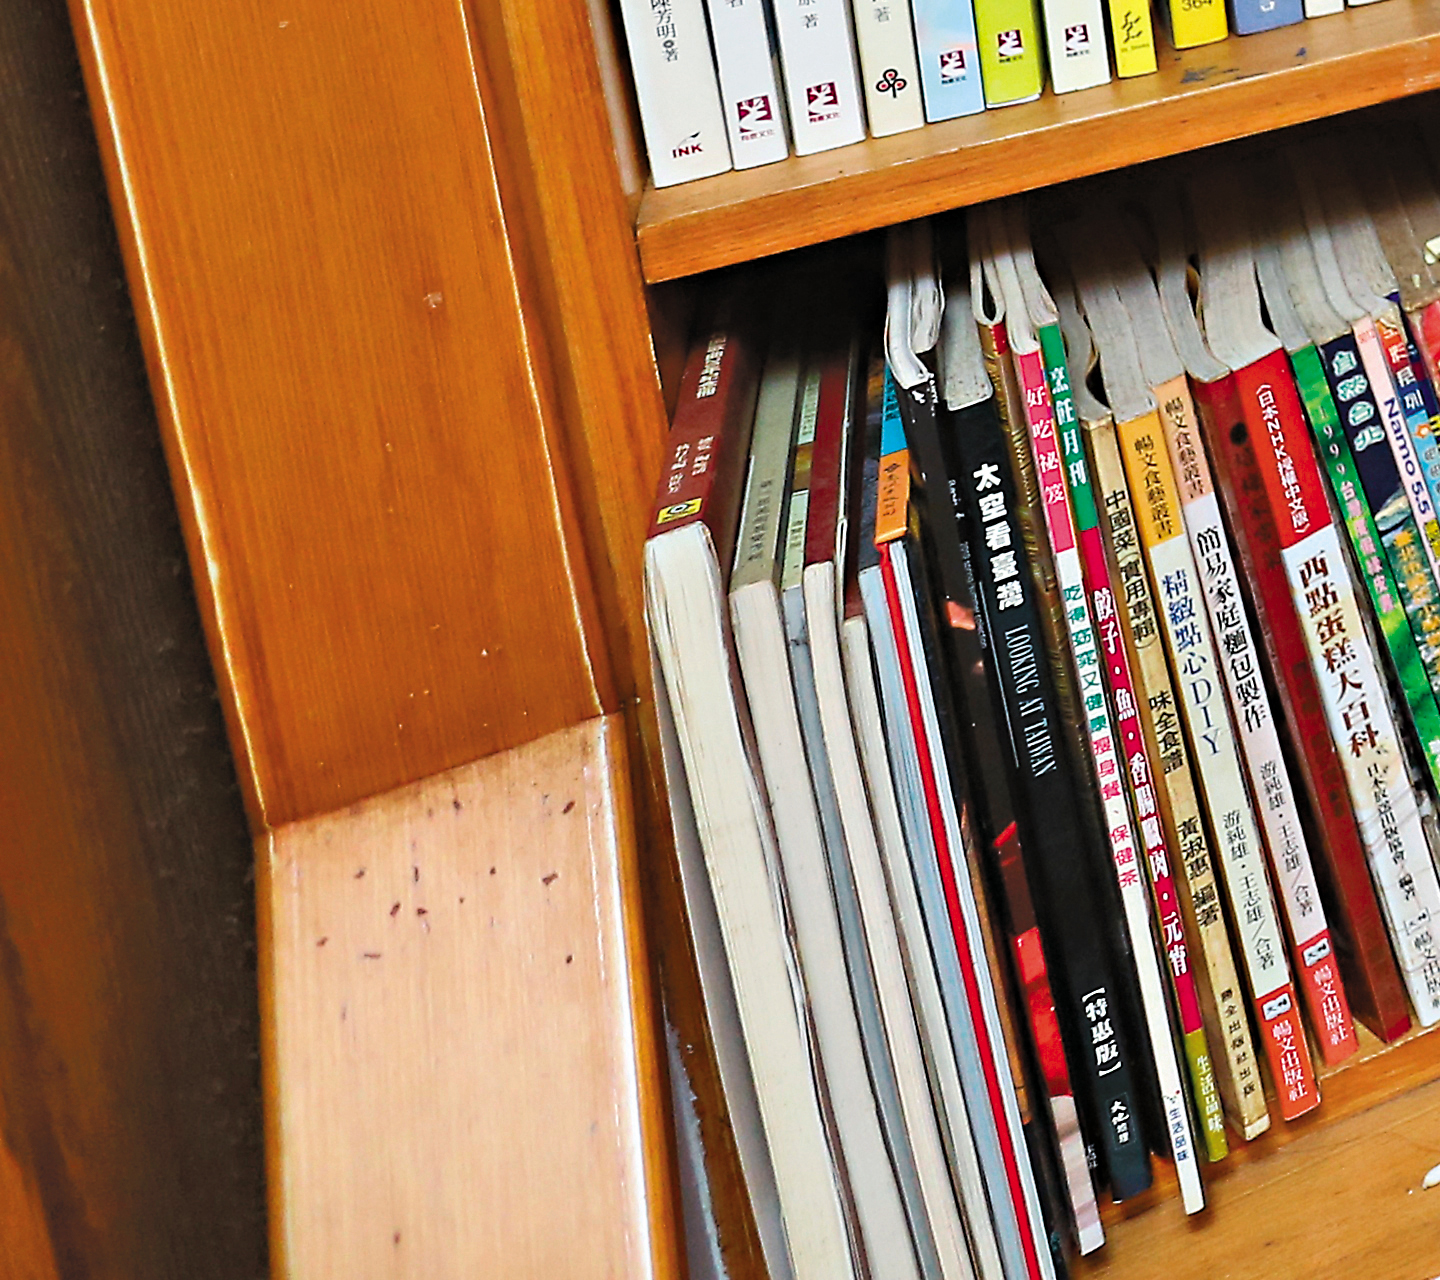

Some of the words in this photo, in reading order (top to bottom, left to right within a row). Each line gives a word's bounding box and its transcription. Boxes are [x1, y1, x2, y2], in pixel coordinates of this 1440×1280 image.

[671, 143, 704, 159] INK
[1384, 397, 1416, 479] Namo
[1409, 481, 1431, 516] 5.5
[972, 462, 1027, 611] 太空看臺灣
[1005, 624, 1040, 695] LOOKING
[1023, 718, 1057, 778] TAIWAN
[1161, 567, 1222, 759] 精緻點心DIY
[1196, 529, 1268, 736] 簡易家庭麵包製作
[1297, 549, 1380, 759] 西點蛋糕大百科
[1270, 1020, 1310, 1104] 暢文出版社
